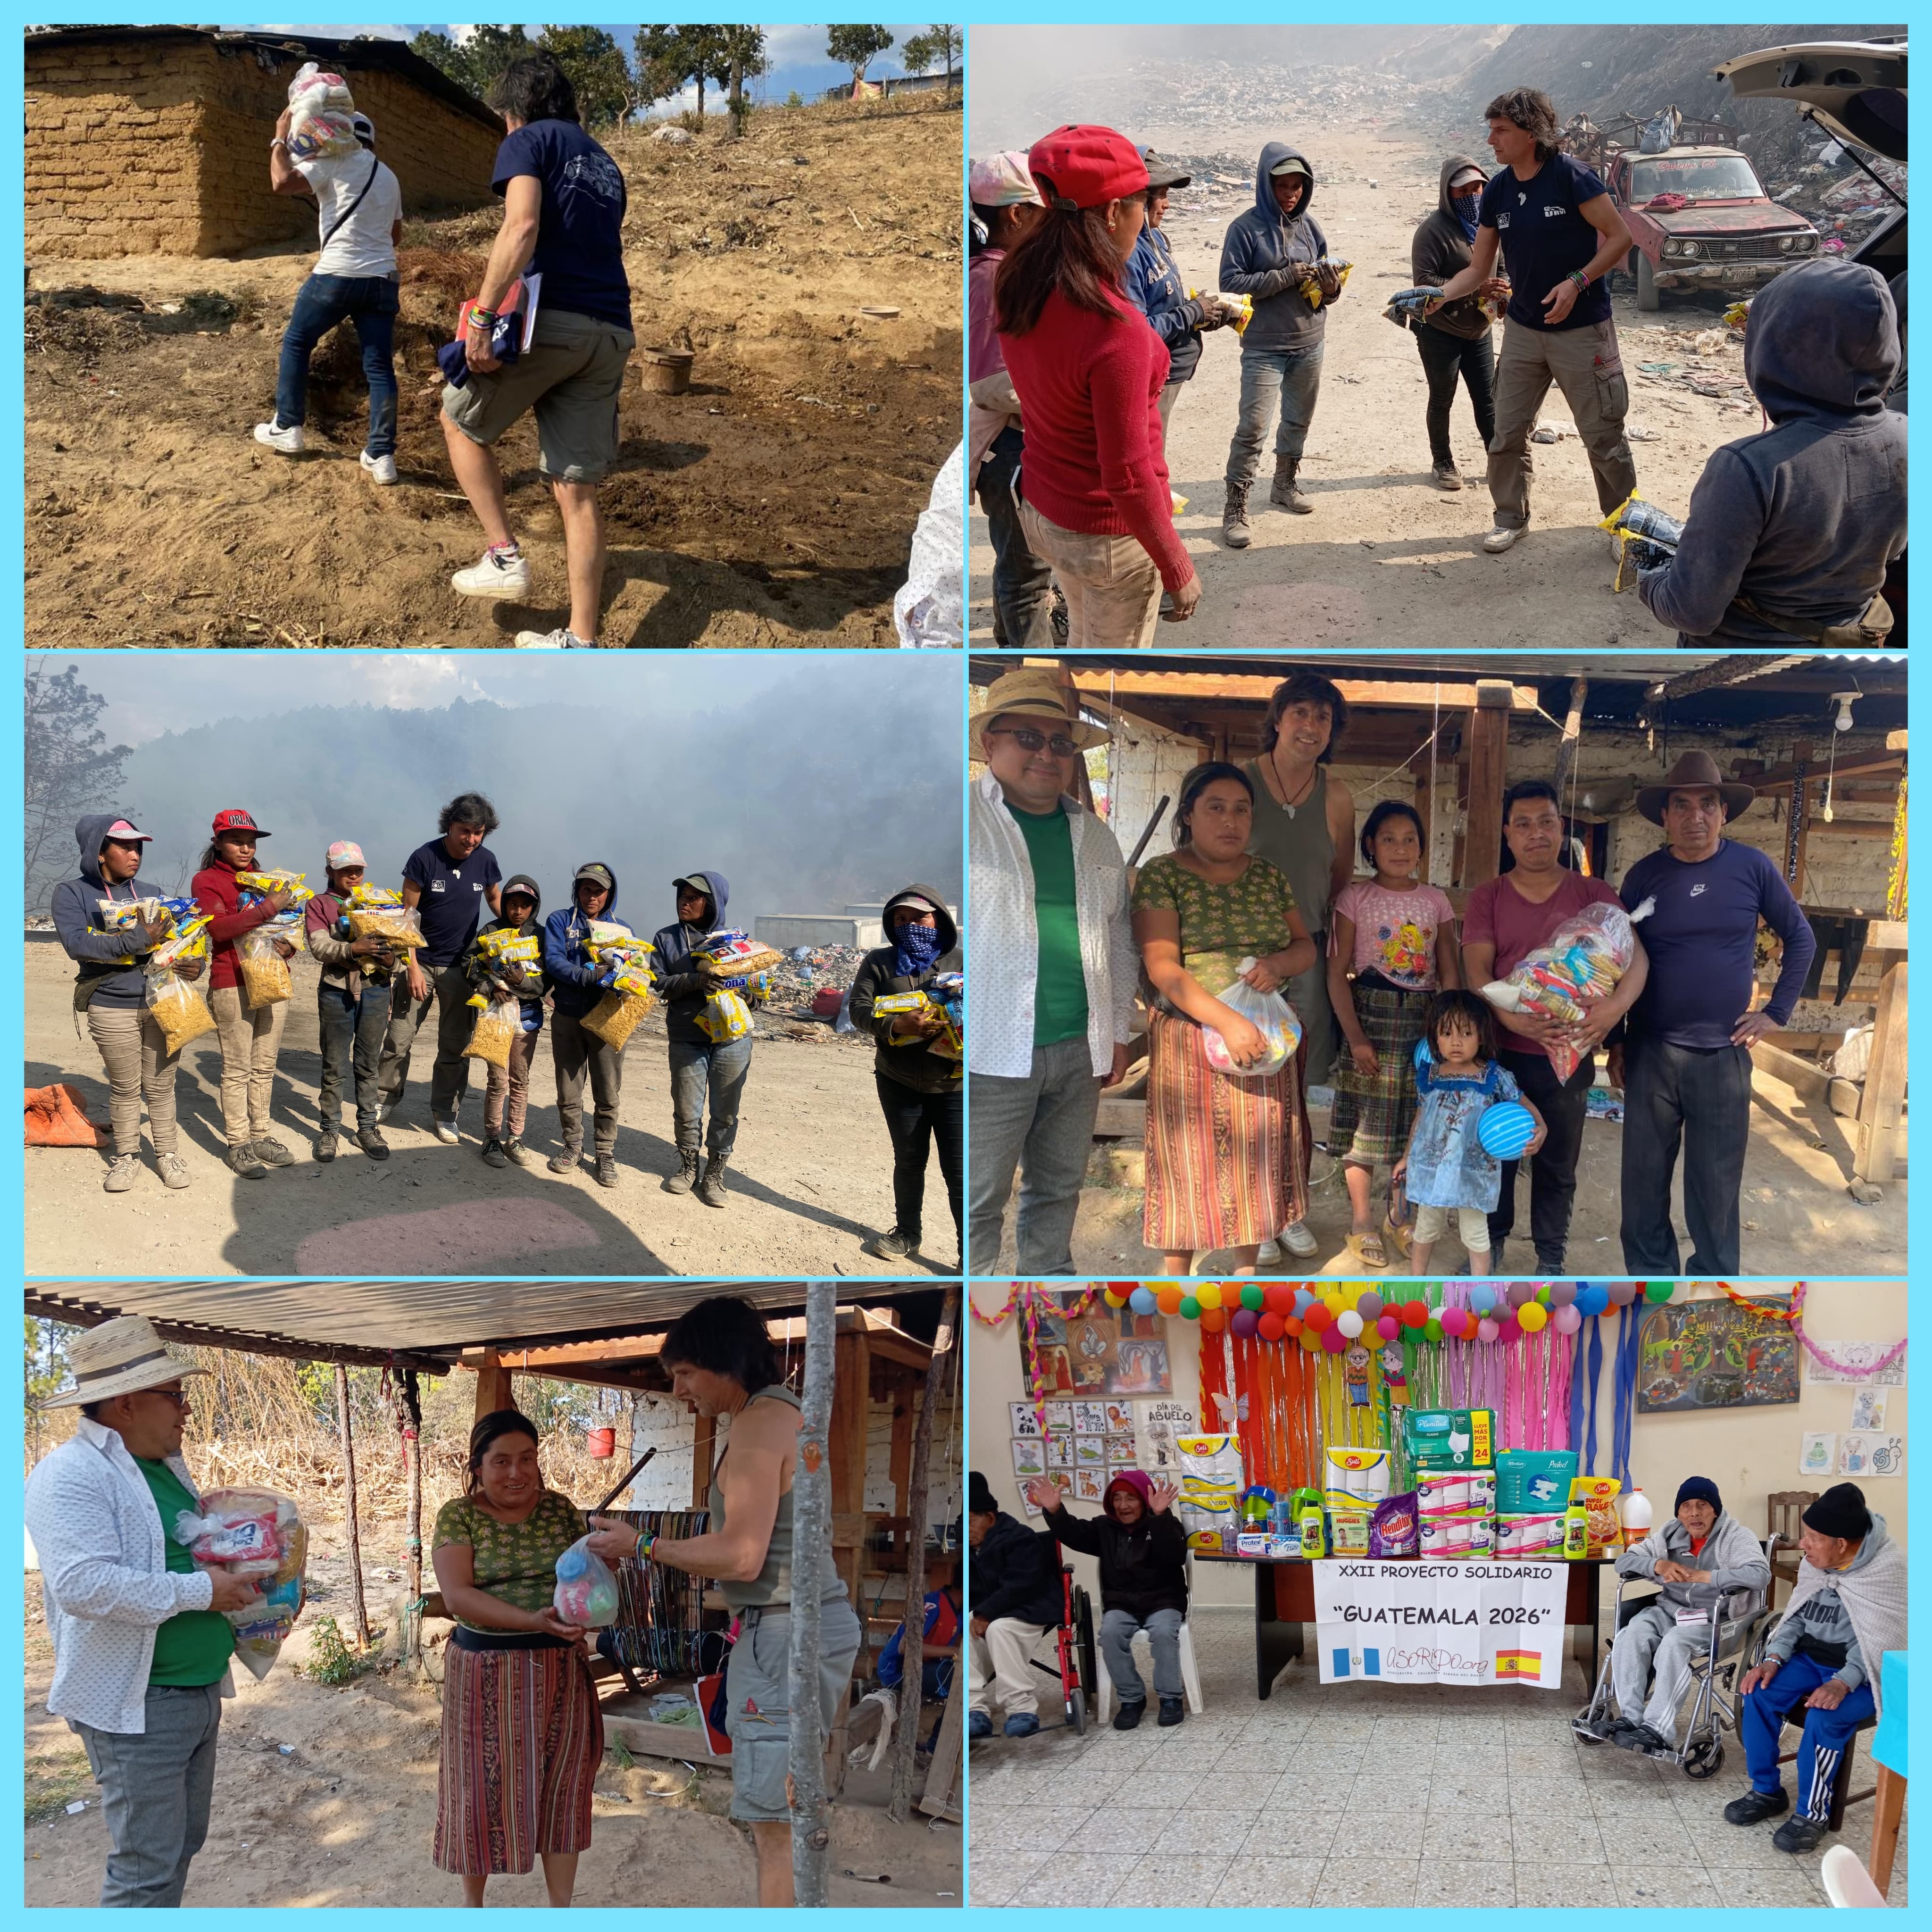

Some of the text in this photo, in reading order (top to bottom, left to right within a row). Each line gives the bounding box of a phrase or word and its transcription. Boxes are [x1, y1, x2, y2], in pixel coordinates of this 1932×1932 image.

[1157, 1402, 1168, 1411] DÍA
[1149, 1411, 1192, 1422] ABUELO
[1417, 1418, 1448, 1428] Plenitud
[1474, 1449, 1488, 1458] 24
[1347, 1457, 1360, 1466] Suli
[1595, 1484, 1609, 1492] Suli
[1470, 1491, 1485, 1503] 12
[1473, 1533, 1488, 1544] 12
[1549, 1532, 1563, 1541] 12
[1339, 1566, 1552, 1579] XXII PROYECTO SOLIDARIO
[1801, 1600, 1841, 1624] UMA
